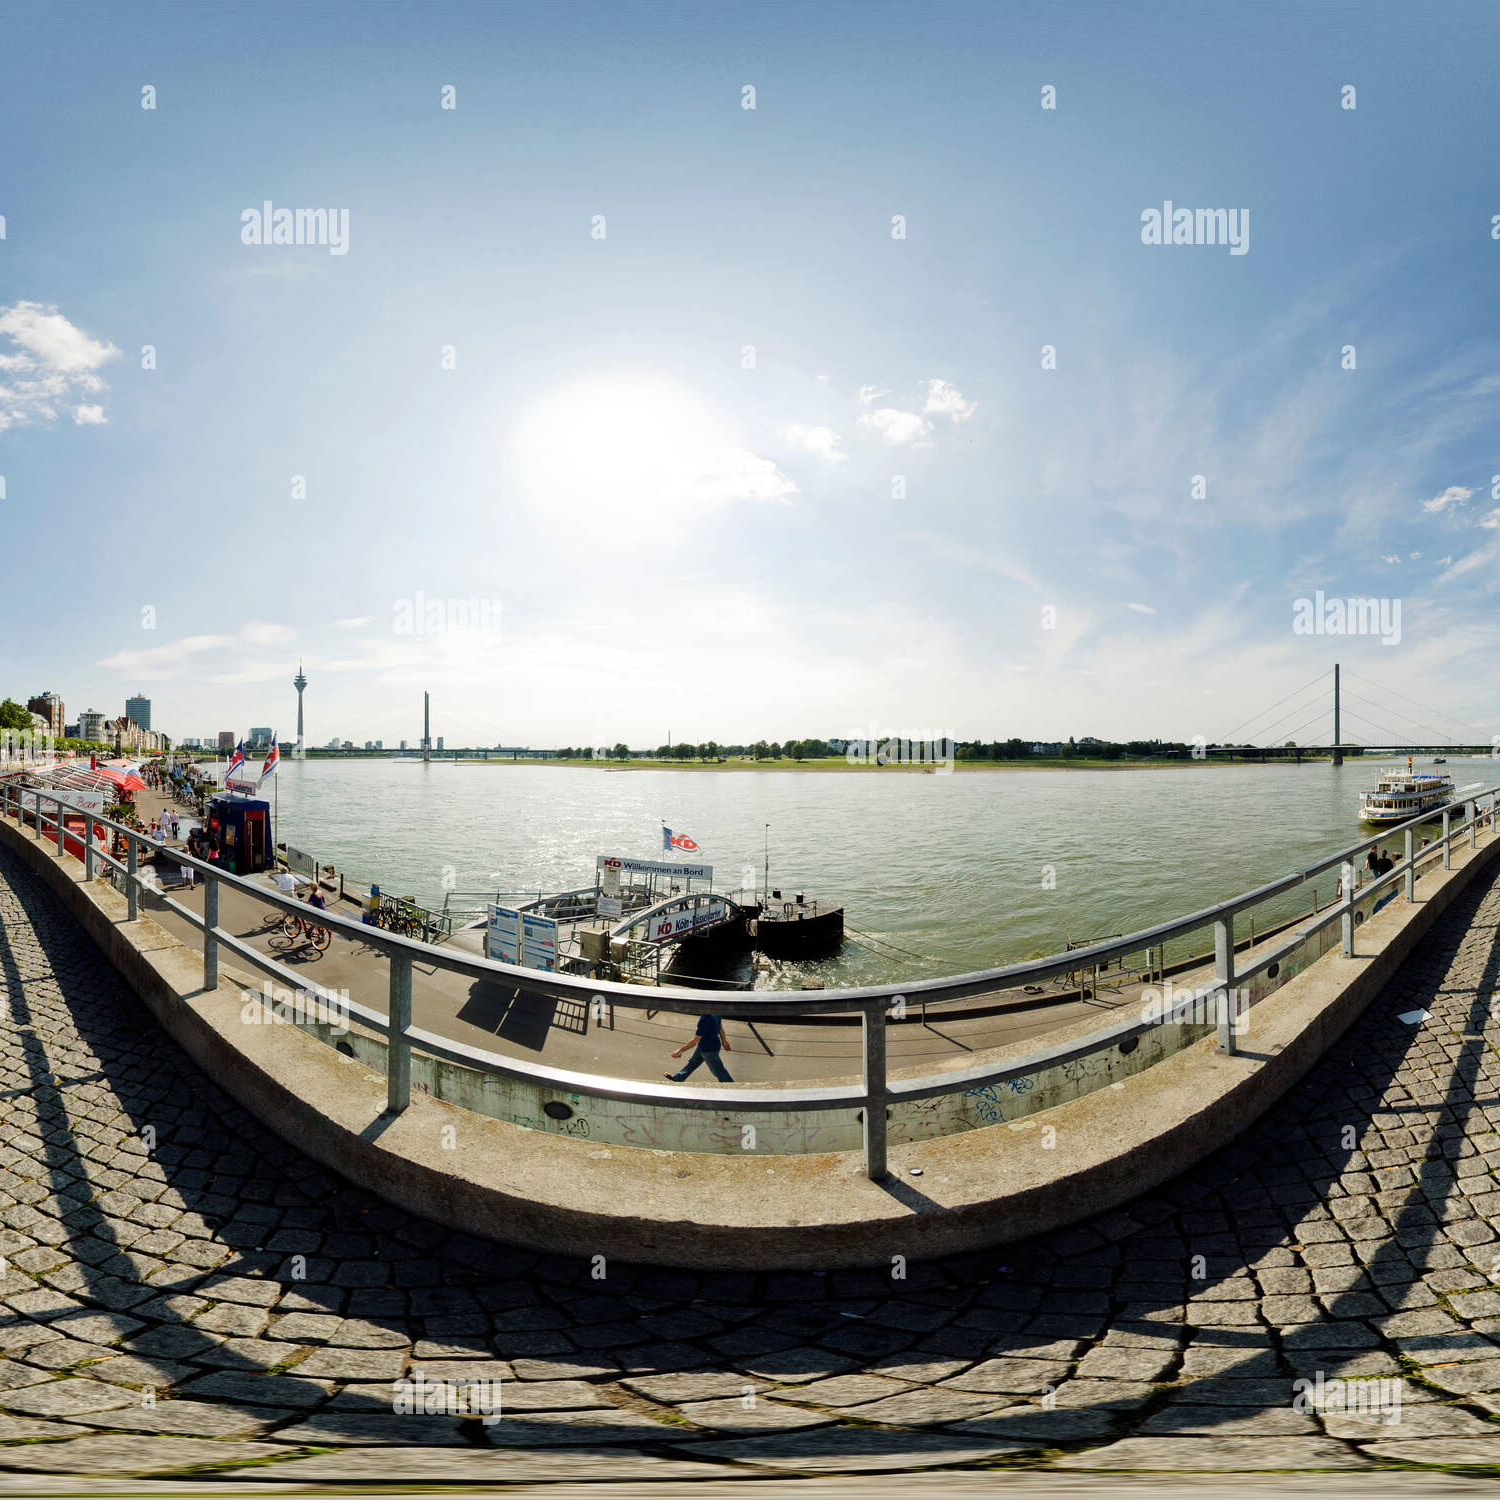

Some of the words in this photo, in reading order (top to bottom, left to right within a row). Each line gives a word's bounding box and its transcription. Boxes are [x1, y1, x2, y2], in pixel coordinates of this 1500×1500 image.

[75, 795, 100, 809] Bar
[604, 859, 621, 869] KD
[624, 862, 671, 874] Willkommen
[683, 867, 704, 876] Bord
[657, 921, 672, 936] KD
